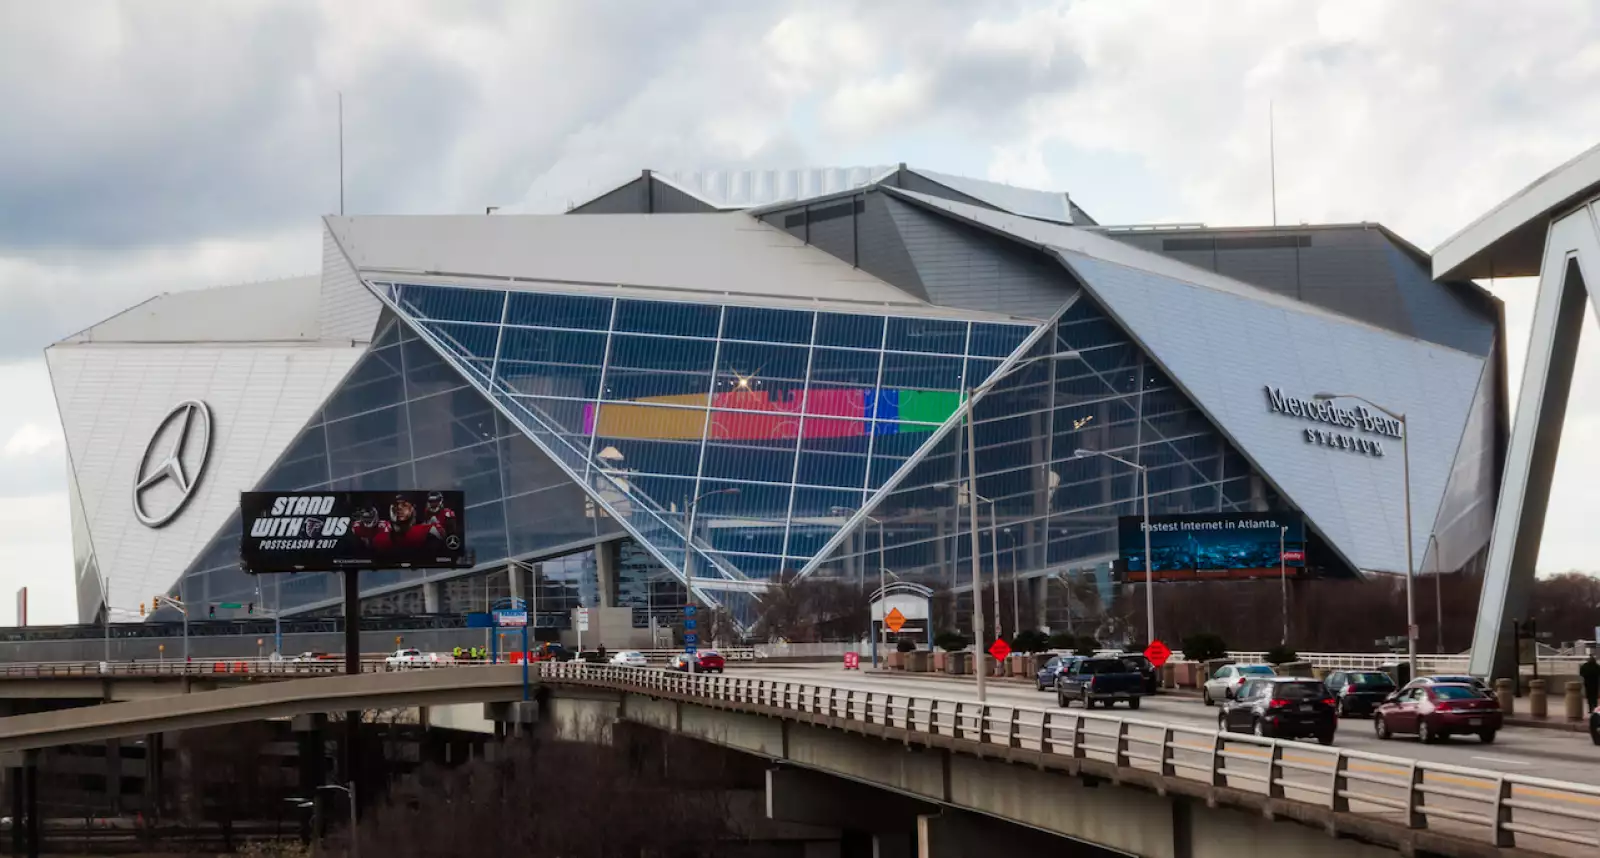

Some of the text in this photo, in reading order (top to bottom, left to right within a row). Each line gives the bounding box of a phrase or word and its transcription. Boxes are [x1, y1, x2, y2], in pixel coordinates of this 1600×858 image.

[1264, 385, 1402, 437] Mercedes-Benz
[1306, 428, 1385, 456] STADIUM
[271, 496, 336, 516] STAND
[250, 517, 350, 537] WITH US
[1140, 519, 1280, 532] Fastest Internet in Atlanta.
[259, 539, 338, 550] POSTSEASON 2017
